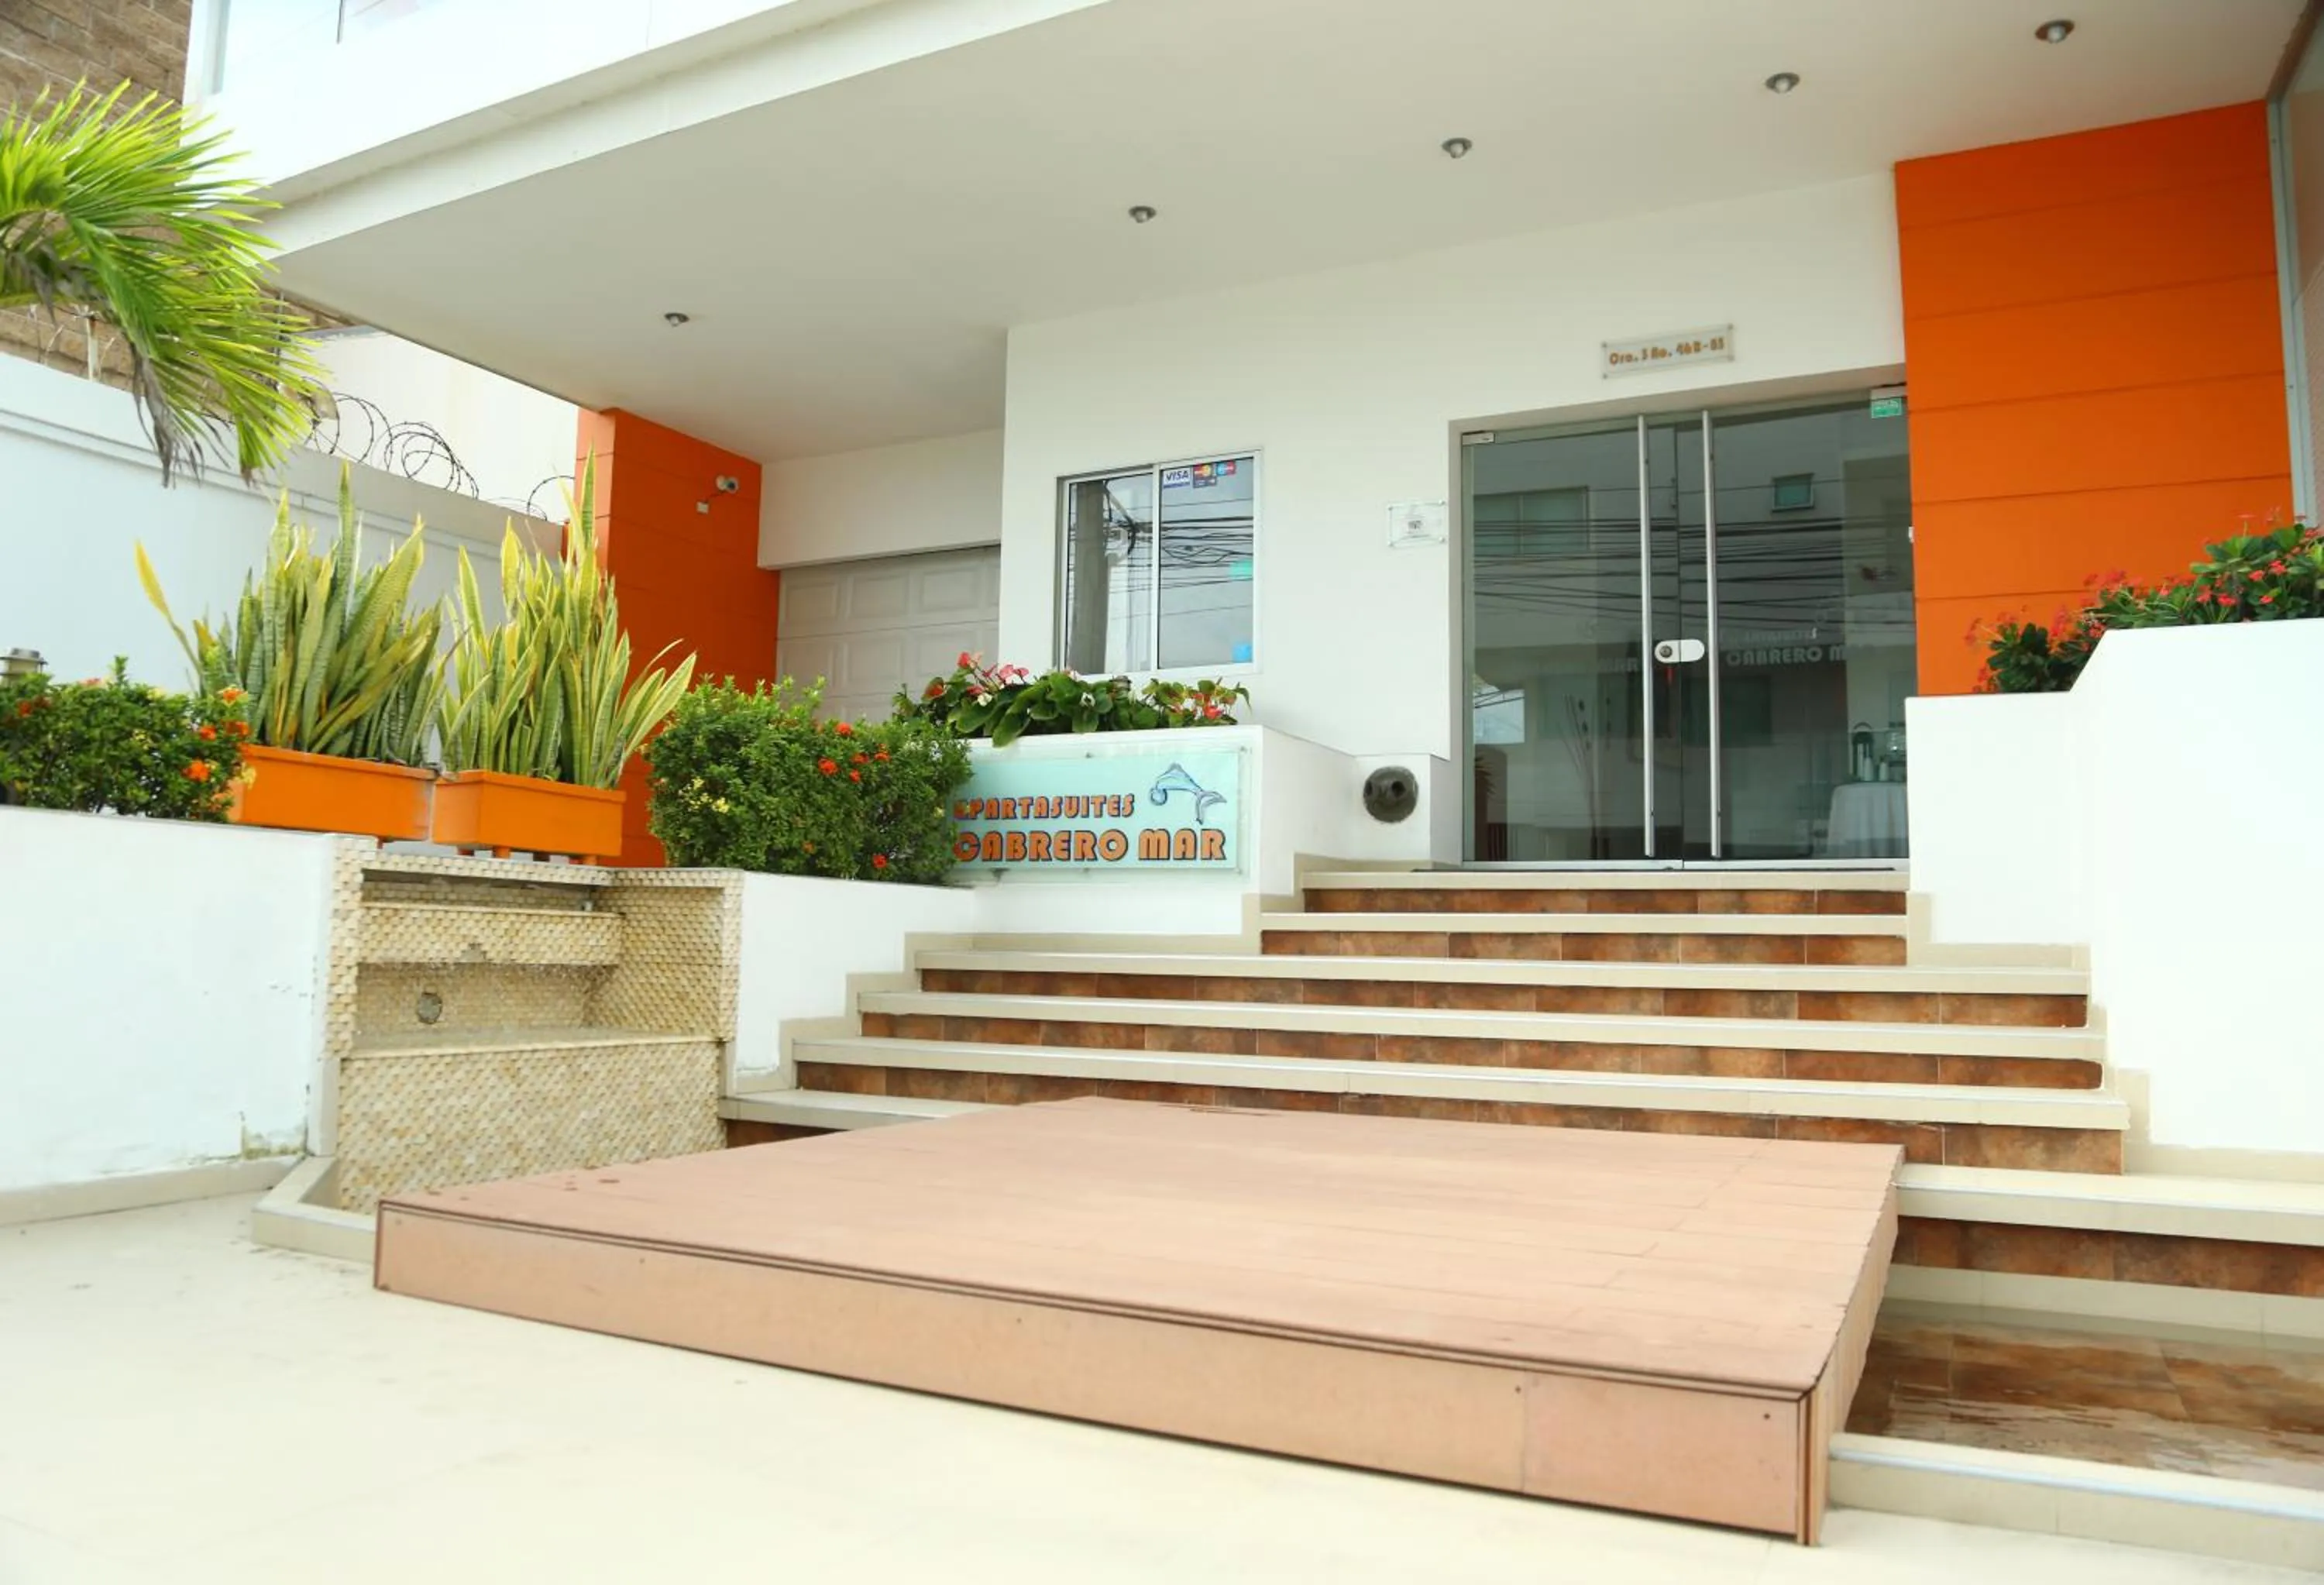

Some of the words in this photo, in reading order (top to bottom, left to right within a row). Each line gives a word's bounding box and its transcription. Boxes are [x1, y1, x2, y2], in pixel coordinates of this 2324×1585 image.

[1166, 470, 1189, 480] VISA
[953, 829, 1129, 862] CABRERO
[1138, 829, 1226, 861] MAR
